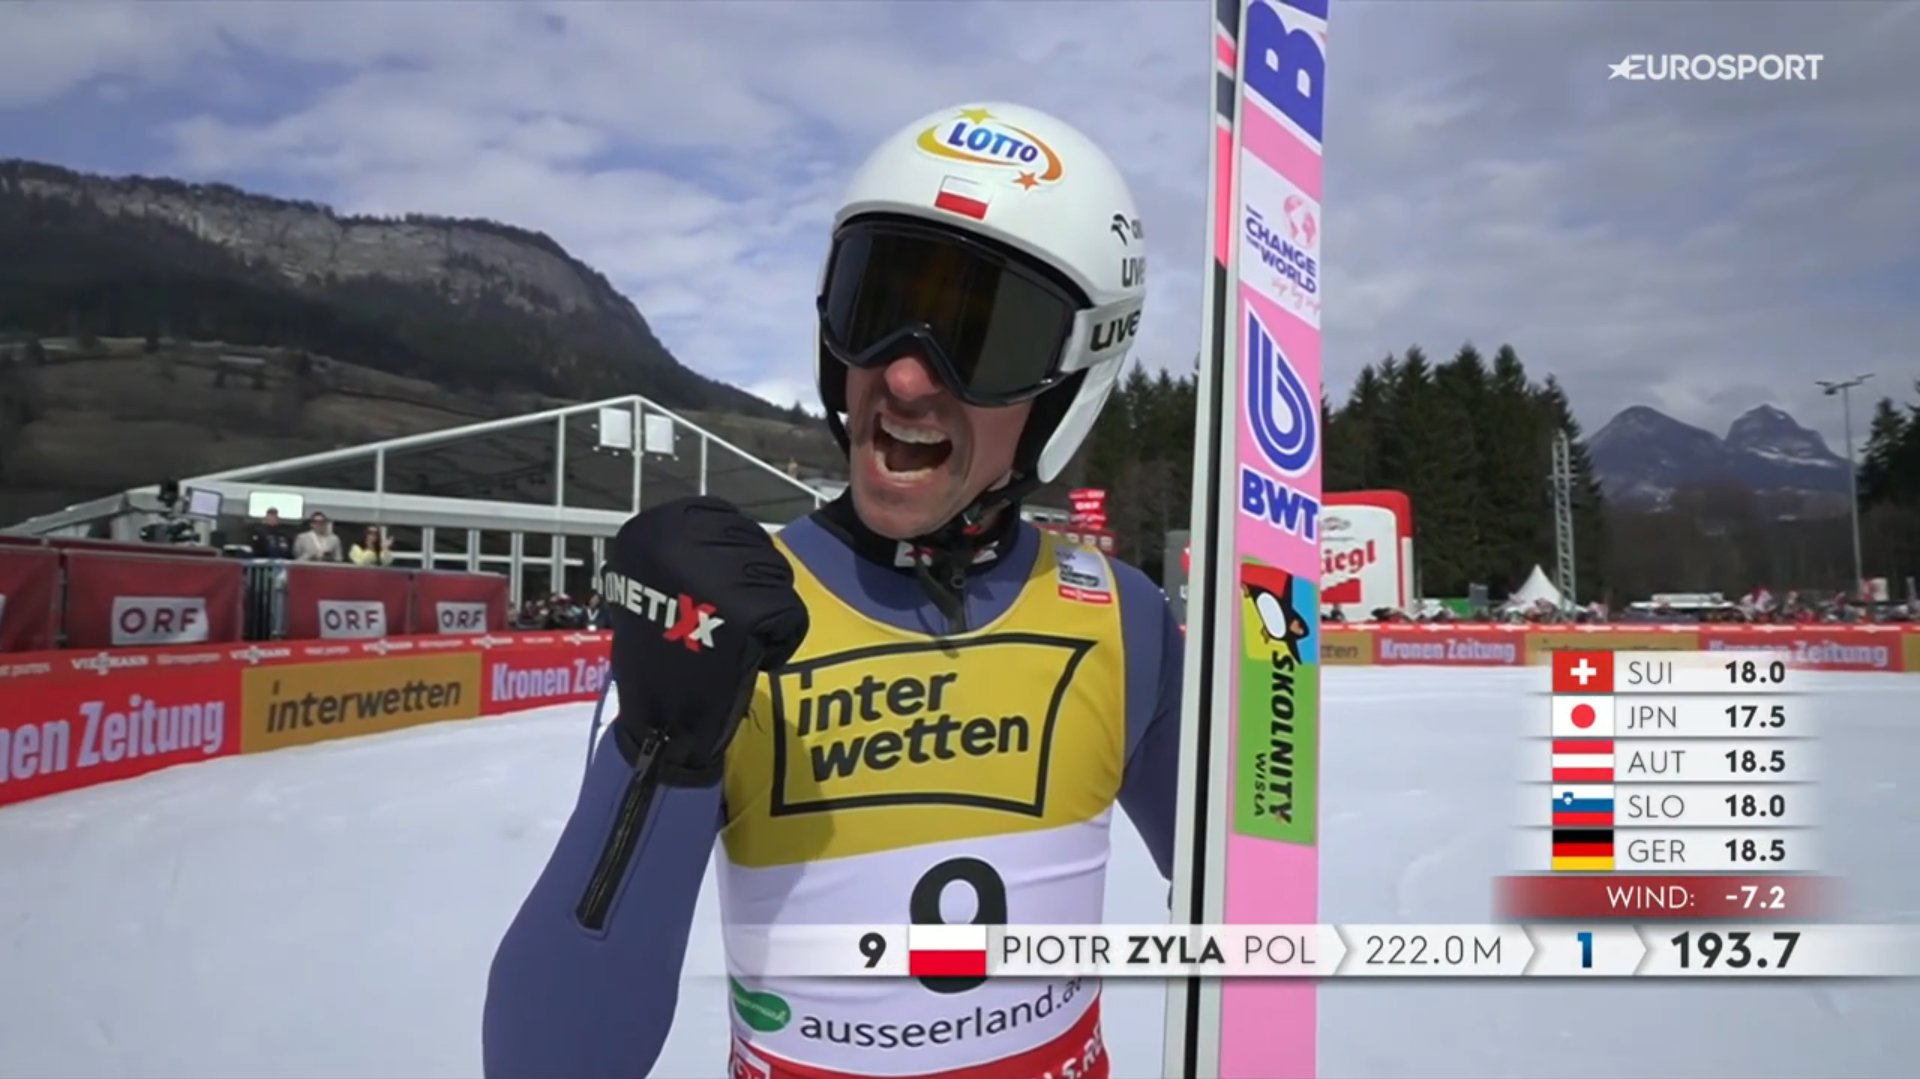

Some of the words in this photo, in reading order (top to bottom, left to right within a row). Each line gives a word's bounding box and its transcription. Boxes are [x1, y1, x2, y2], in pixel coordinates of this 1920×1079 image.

[947, 122, 1038, 162] LOTTO
[1245, 217, 1316, 278] CHANGE
[1260, 245, 1316, 294] WORLD
[1242, 468, 1318, 540] BWT
[1321, 539, 1376, 574] iegl
[119, 607, 199, 634] ORF
[324, 608, 380, 630] ORF
[441, 610, 483, 628] ORF
[1380, 638, 1444, 659] Kronen
[1446, 638, 1516, 663] Zeitung
[1798, 640, 1888, 666] Zeitung
[491, 662, 569, 701] Kronen
[572, 656, 610, 694] Zei
[265, 679, 461, 733] interwetten
[798, 669, 958, 737] inter
[76, 693, 225, 768] Zeitung
[810, 713, 1029, 783] wetten
[1269, 650, 1297, 825] SKOLNITY
